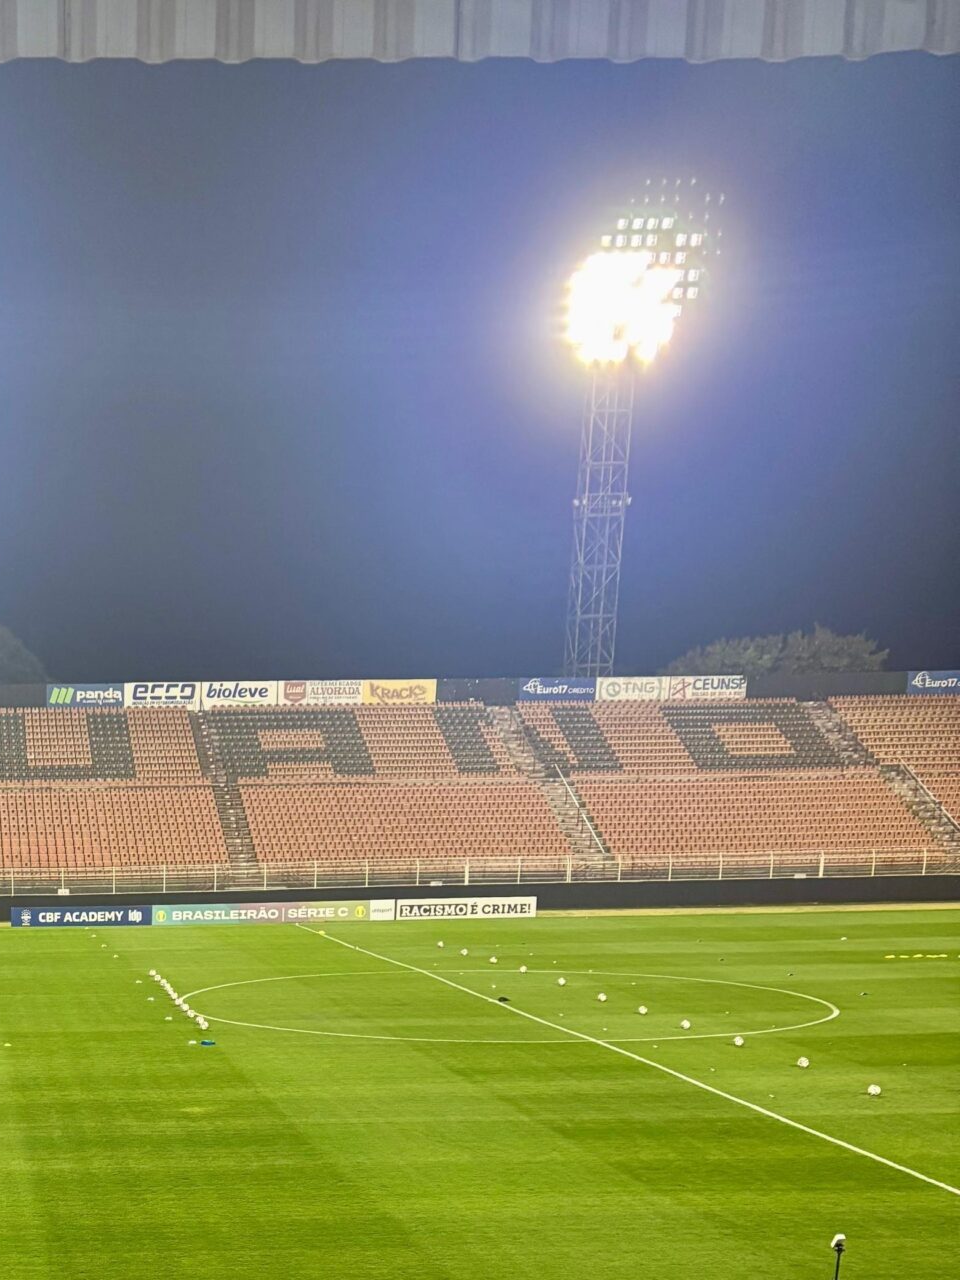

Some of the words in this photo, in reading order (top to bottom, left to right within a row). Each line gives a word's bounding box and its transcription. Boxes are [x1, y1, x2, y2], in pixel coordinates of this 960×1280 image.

[621, 683, 655, 694] TNG
[693, 678, 747, 690] CEUNSP
[926, 678, 958, 688] Euro17
[76, 687, 122, 704] panda
[206, 682, 269, 699] bioleve
[310, 686, 361, 696] ALVORADA
[536, 685, 567, 695] Euro17
[172, 908, 279, 921] BRASILEIRÃO
[288, 905, 335, 918] SÉRIE
[337, 907, 349, 917] C
[401, 904, 467, 917] RACISMO
[470, 901, 478, 915] É
[483, 903, 531, 915] CRIME!
[38, 912, 60, 923] CBF
[63, 911, 123, 922] ACADEMY
